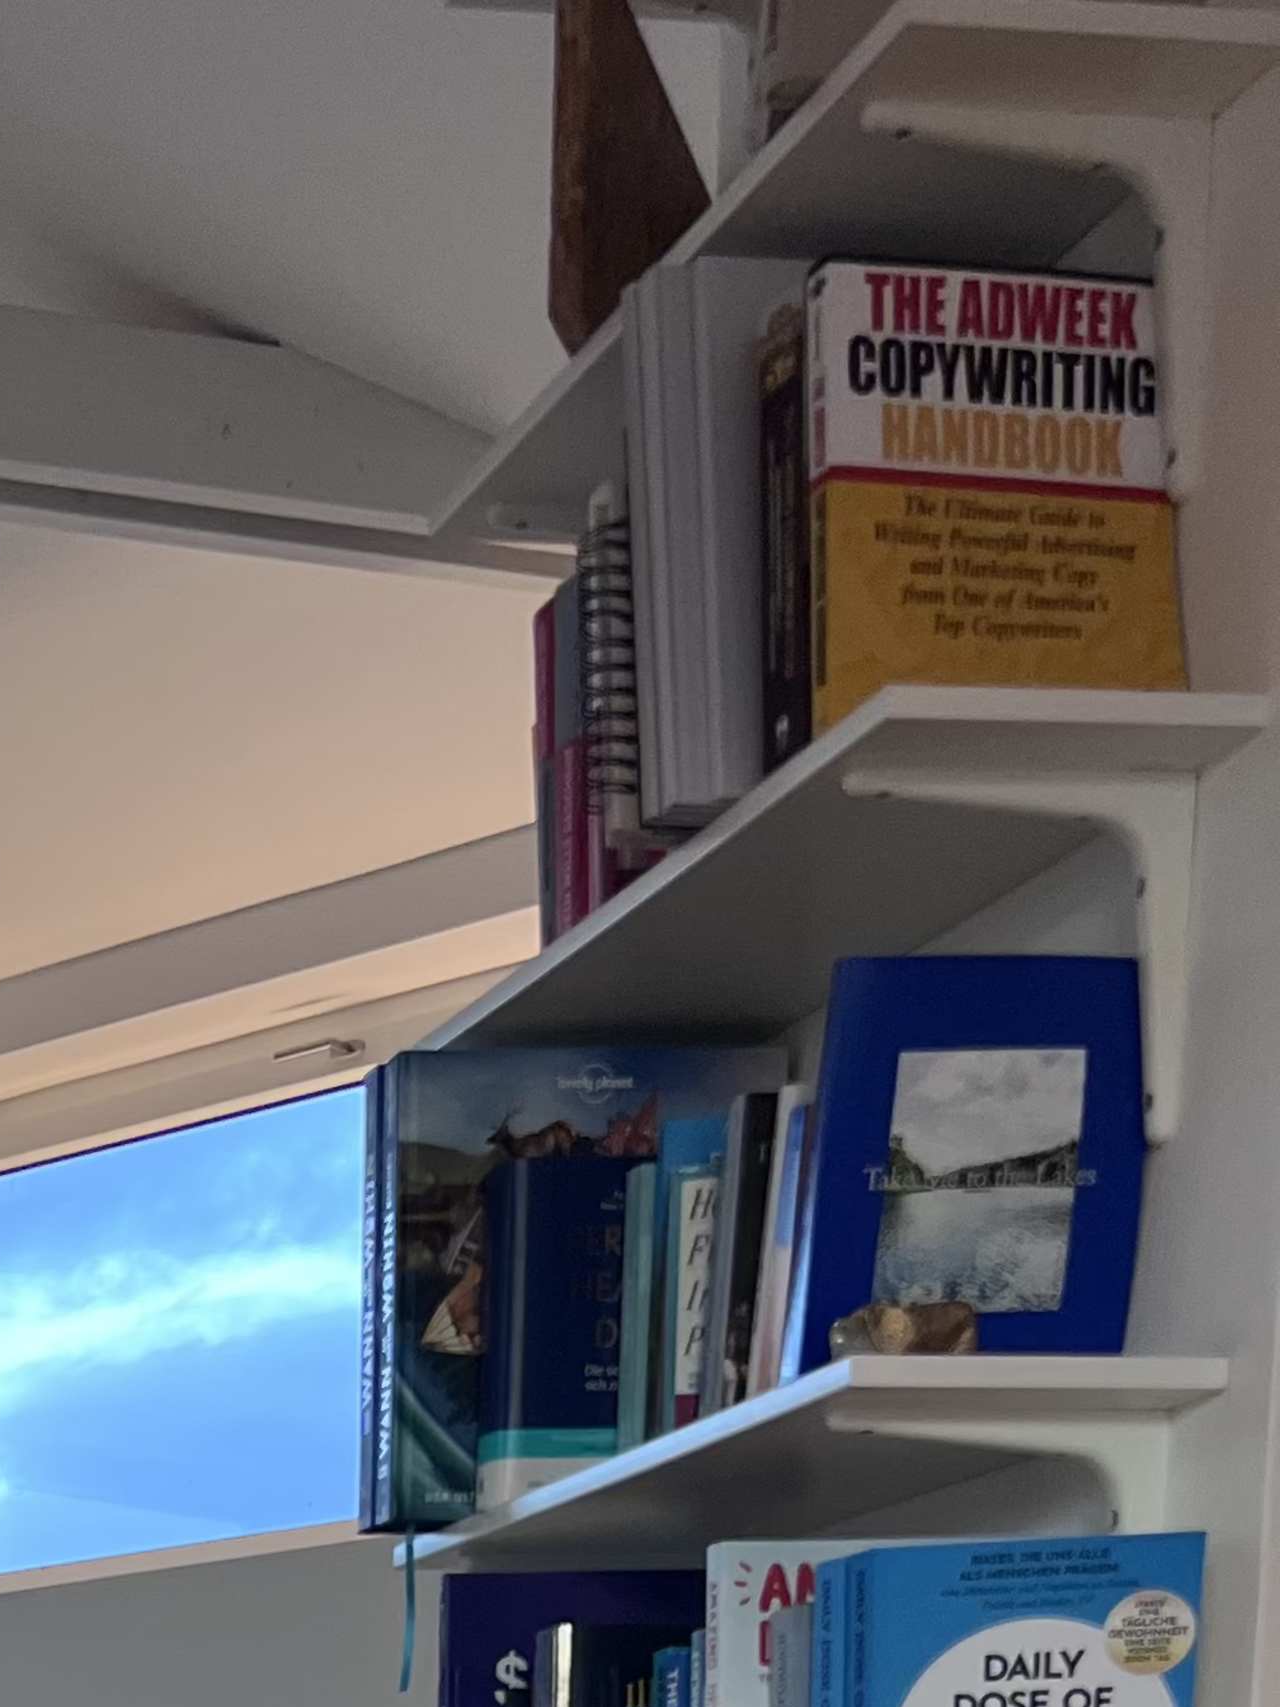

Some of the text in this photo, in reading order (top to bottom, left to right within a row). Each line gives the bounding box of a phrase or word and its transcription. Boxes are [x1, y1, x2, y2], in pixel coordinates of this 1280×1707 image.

[865, 273, 1139, 350] THE ADWEEK
[848, 335, 1156, 416] COPYWRITING
[881, 403, 1124, 478] HANDBOOK
[1087, 508, 1106, 528] to
[874, 523, 941, 552] Writing
[911, 557, 1097, 586] and Marketing Copy
[901, 585, 945, 605] from
[994, 587, 1014, 610] of
[932, 614, 964, 637] Top
[863, 1166, 912, 1192] Take
[1035, 1162, 1098, 1187] Lakes
[1108, 1625, 1189, 1639] GEWOHNHEIT
[983, 1649, 1085, 1683] DAILY
